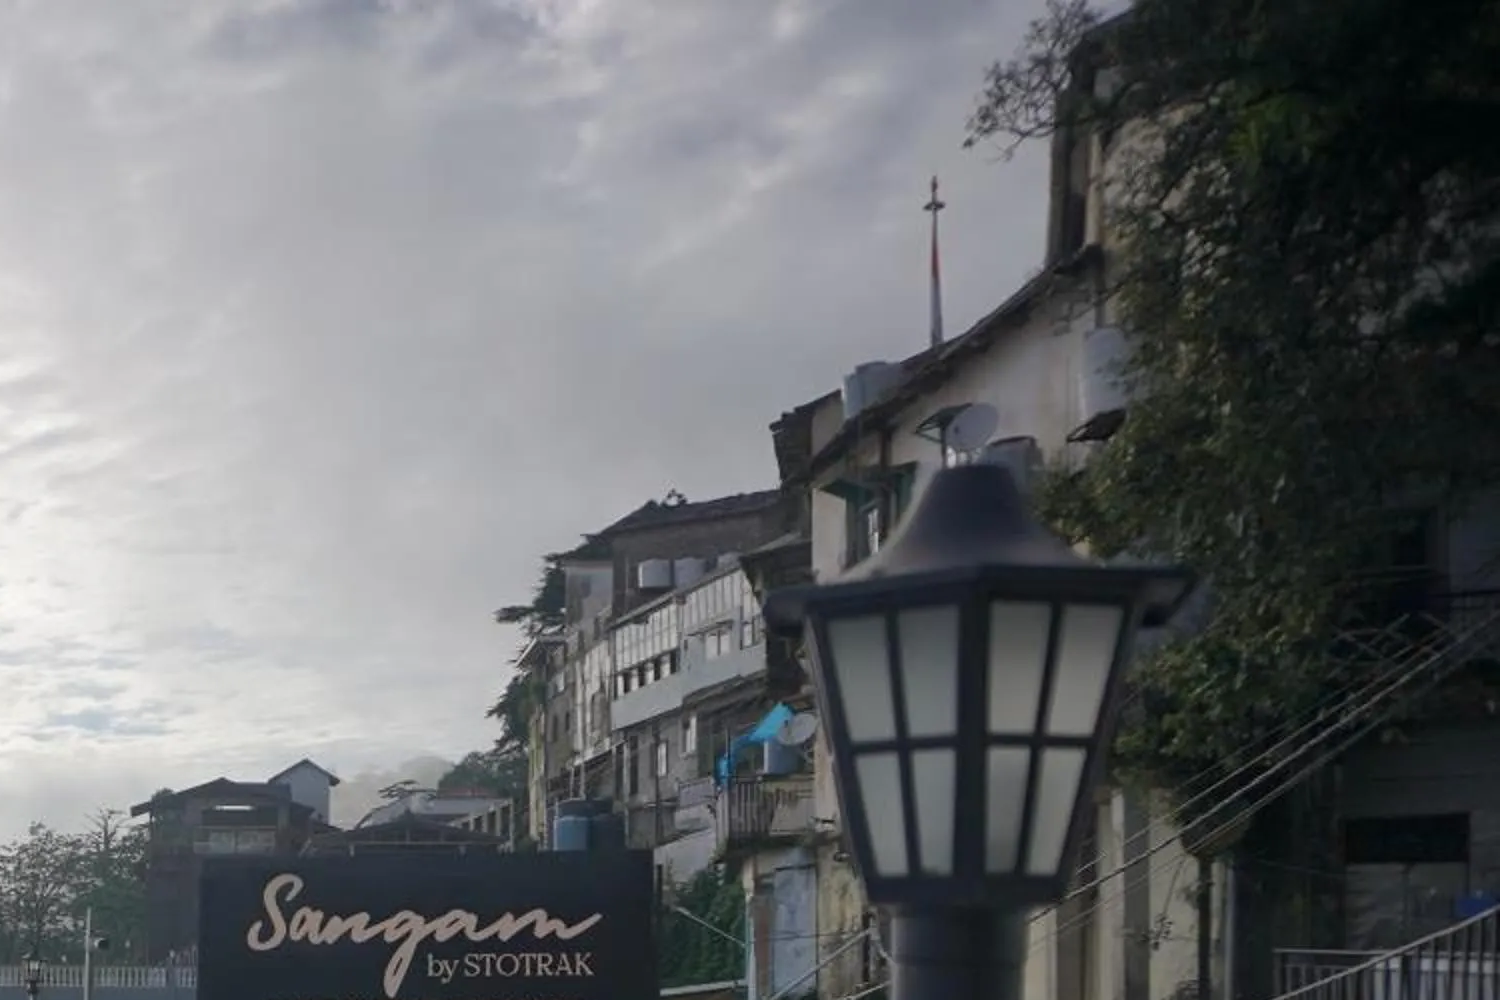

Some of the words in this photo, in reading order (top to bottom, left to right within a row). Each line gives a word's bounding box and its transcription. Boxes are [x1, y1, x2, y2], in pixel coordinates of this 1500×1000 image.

[247, 873, 602, 999] Sangam
[427, 953, 459, 983] by
[464, 952, 594, 977] STOTRAK
